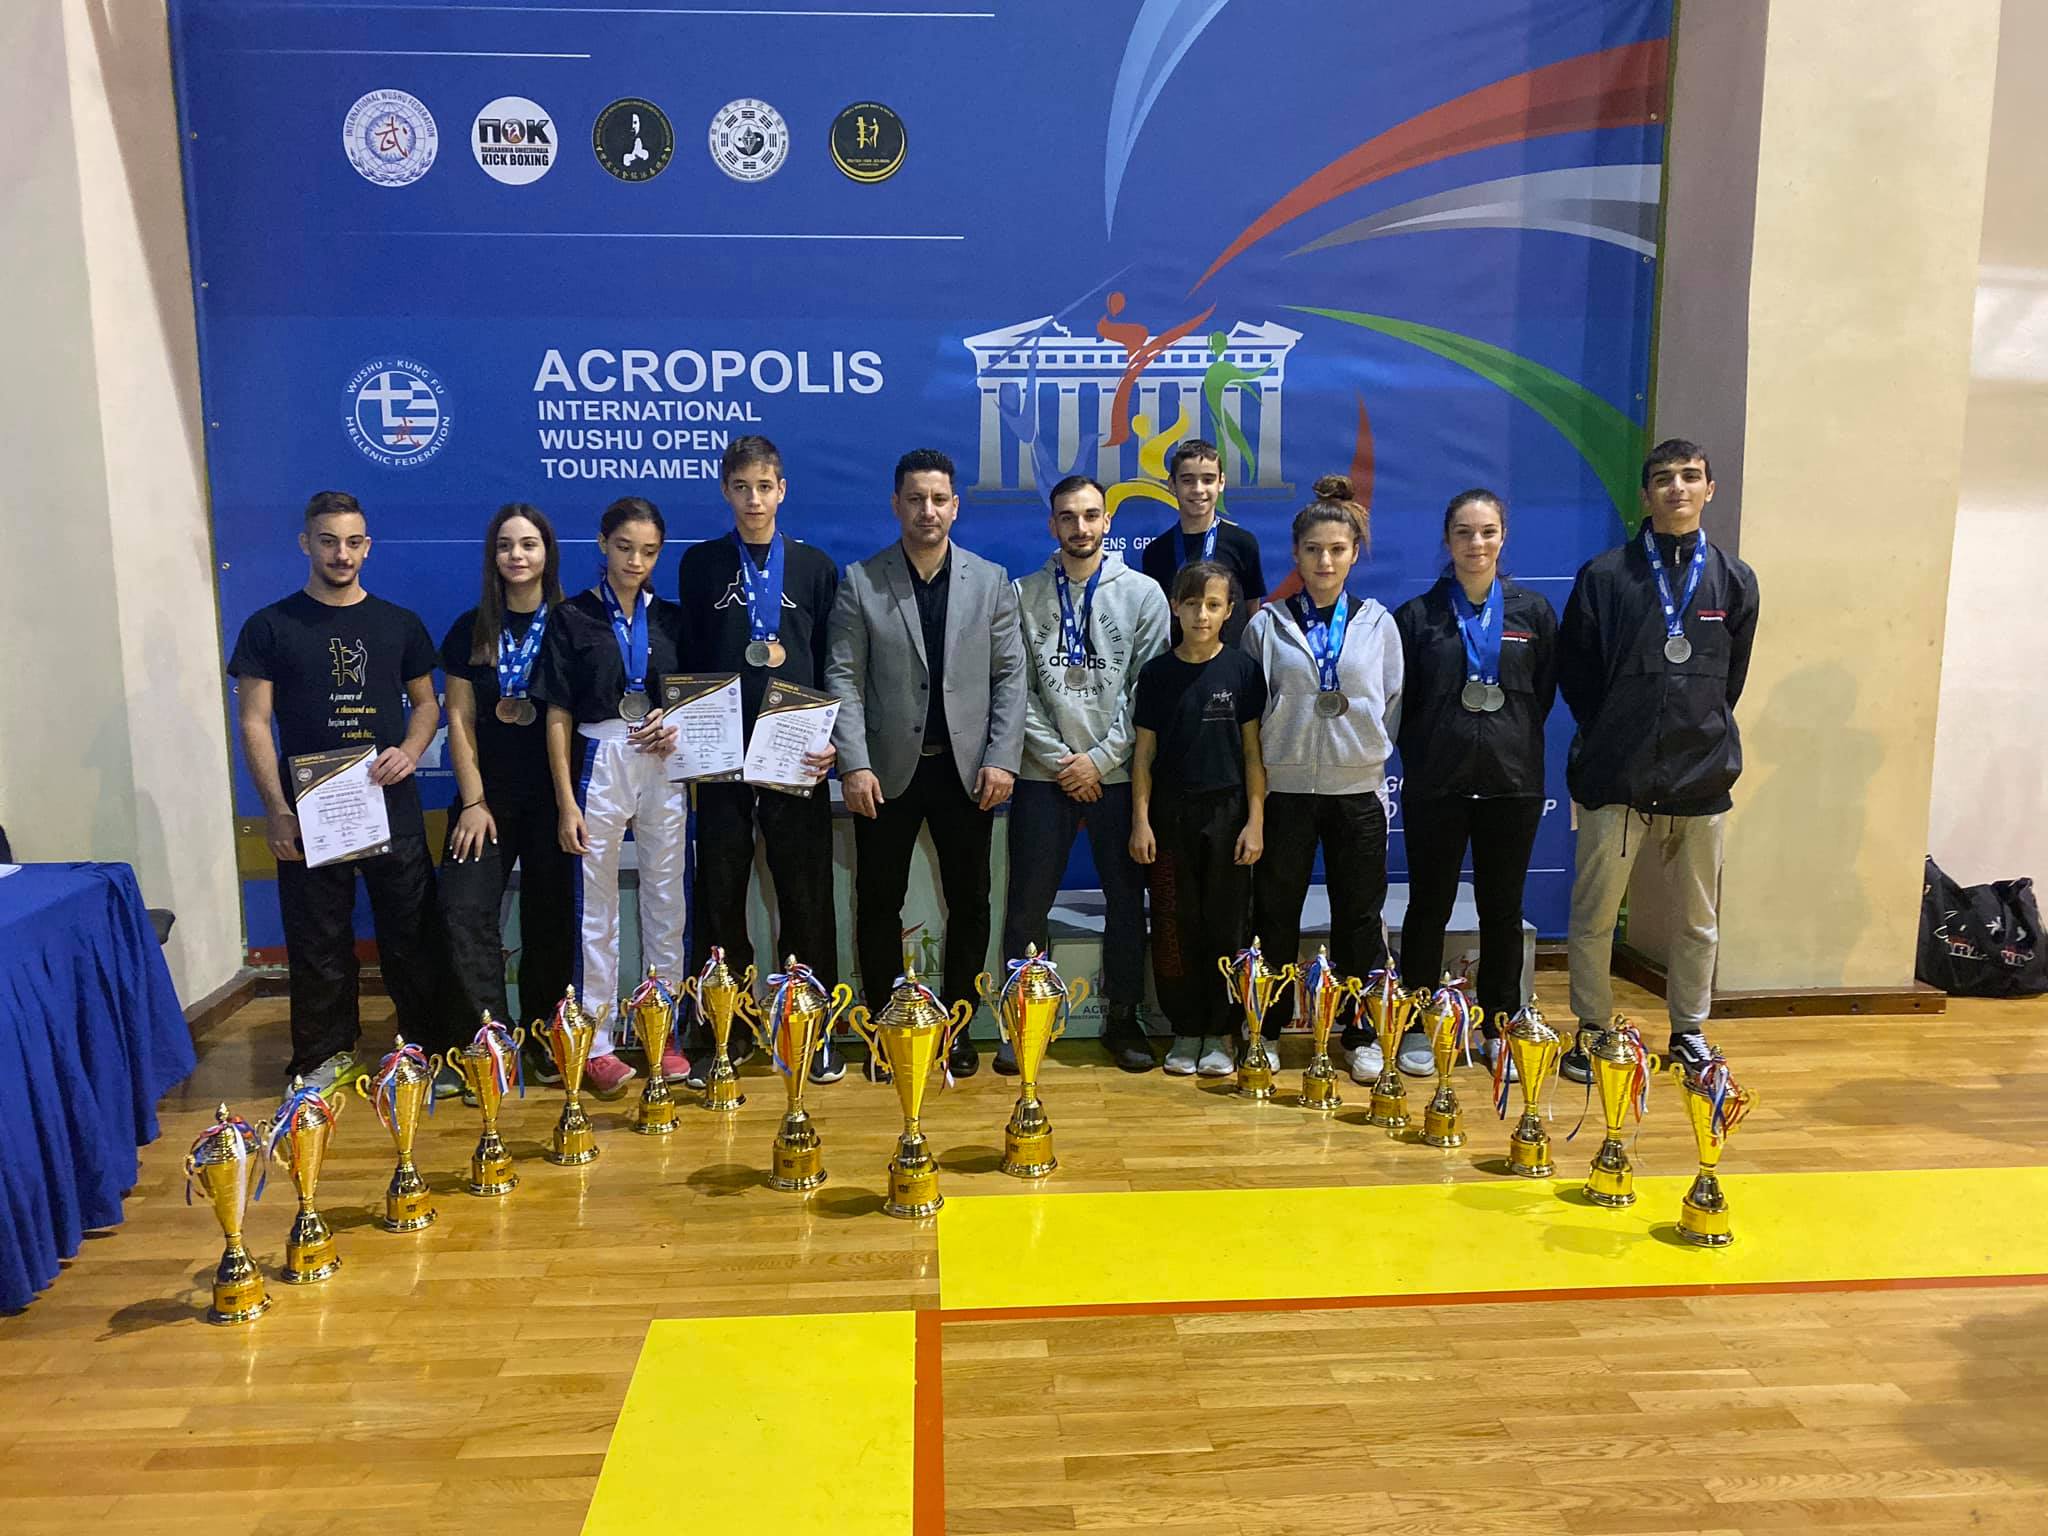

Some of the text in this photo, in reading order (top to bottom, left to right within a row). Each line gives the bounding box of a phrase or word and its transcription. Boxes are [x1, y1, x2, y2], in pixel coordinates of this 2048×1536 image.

[345, 92, 435, 137] INTERNATIONAL WUSHU FEDERATION
[482, 153, 549, 167] KICK BOXING
[347, 361, 383, 393] WUSHU
[397, 360, 429, 378] KUNG
[431, 379, 445, 394] FU
[533, 349, 884, 394] ACROPOLIS
[538, 400, 762, 422] INTERNATIONAL
[345, 416, 450, 466] HELLENIC FEDERATION
[539, 430, 729, 451] WUSHU OPEN
[541, 458, 725, 480] TOURNAMEN
[1102, 537, 1127, 550] ENS
[1034, 623, 1051, 646] THE
[1098, 613, 1122, 643] WITH
[1110, 650, 1124, 674] THE
[1049, 654, 1106, 670] adas
